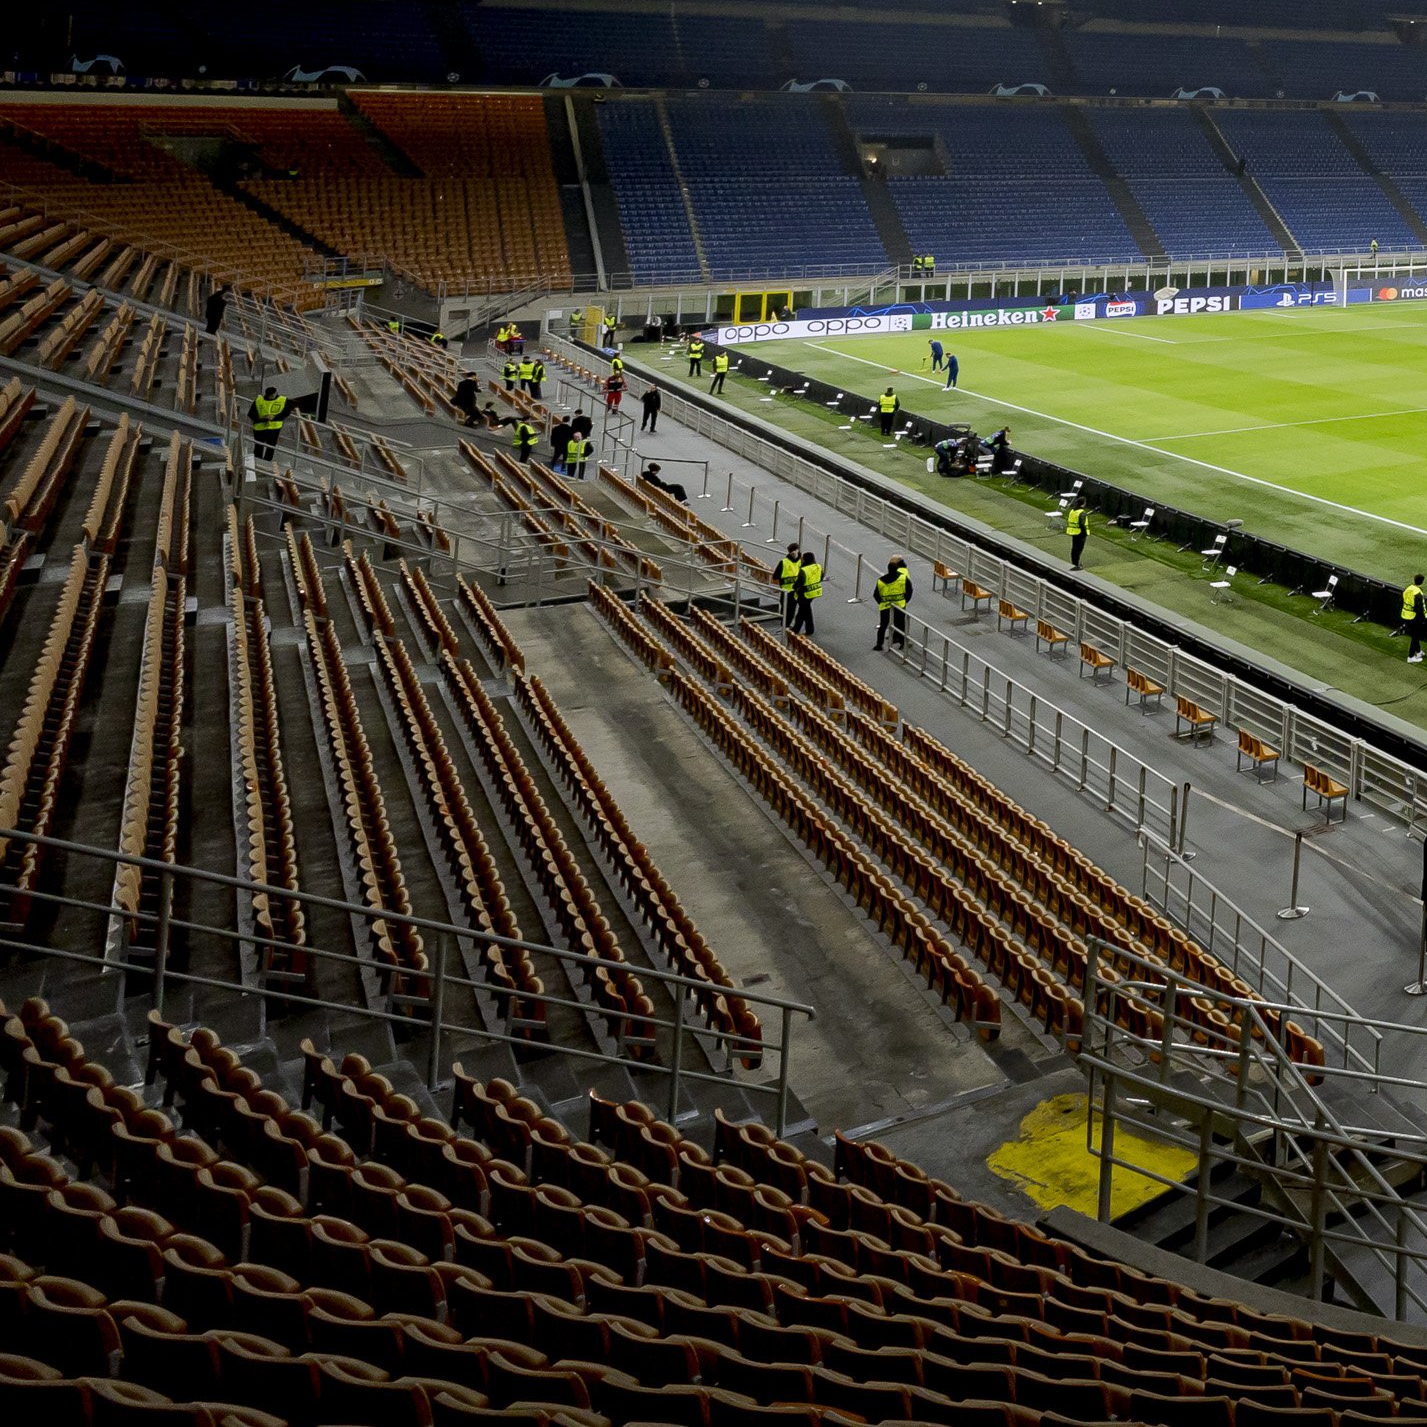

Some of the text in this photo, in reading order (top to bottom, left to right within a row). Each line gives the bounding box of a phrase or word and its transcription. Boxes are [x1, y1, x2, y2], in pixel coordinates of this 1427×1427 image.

[1157, 295, 1231, 315] PEPSI
[1298, 292, 1337, 304] PS5
[930, 308, 1039, 329] Heineken
[1108, 306, 1134, 314] PEPSI
[725, 322, 790, 342] oppo
[807, 317, 881, 334] oppo
